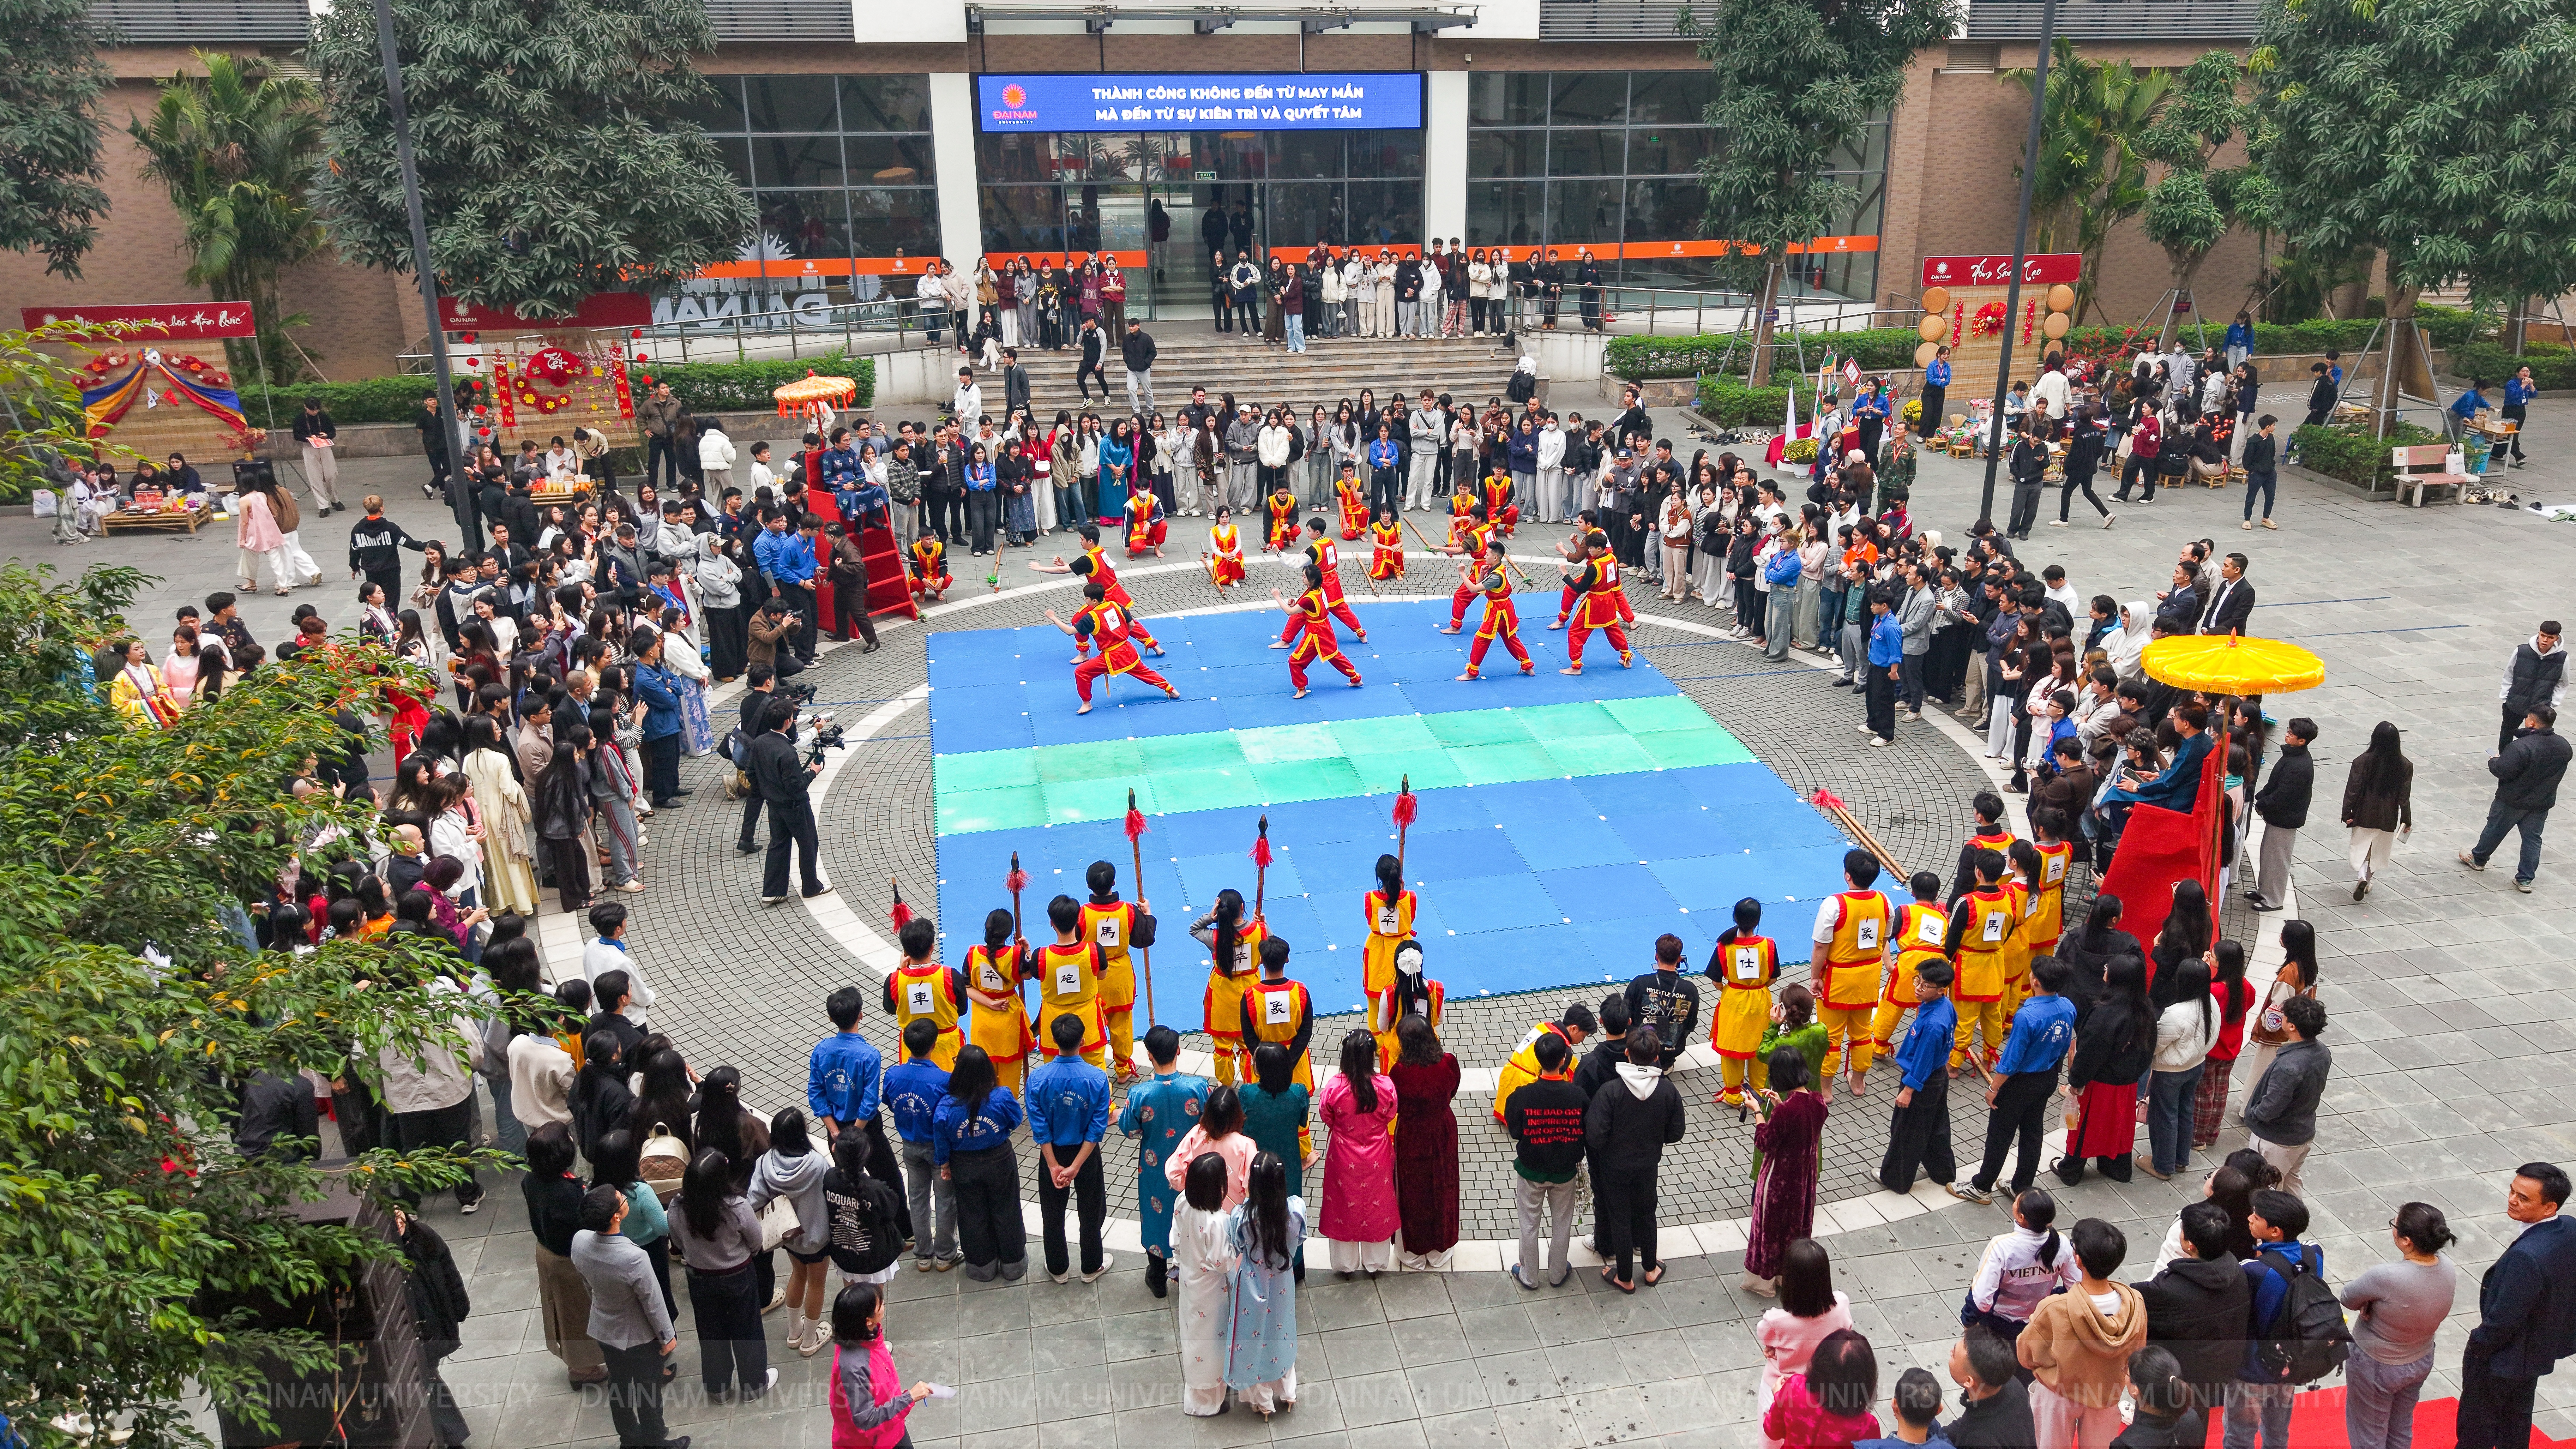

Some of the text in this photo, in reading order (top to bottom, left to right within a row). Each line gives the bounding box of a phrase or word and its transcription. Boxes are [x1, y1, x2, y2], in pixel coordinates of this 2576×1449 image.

[1092, 83, 1364, 99] THÀNH CÔNG KHÔNG ĐẾN TỪ MAY MẮN
[1095, 104, 1362, 122] MÀ ĐẾN TỪ SỰ KIÊN TRÌ VÀ QUYẾT TÂM
[1997, 262, 2012, 279] Sán
[2024, 260, 2041, 282] Tạo
[2051, 863, 2062, 874] 卒
[1381, 914, 1395, 926] 卒
[1987, 920, 1999, 932] 馬
[1101, 926, 1115, 938] 馬
[1861, 927, 1874, 940] 象
[1740, 958, 1755, 968] 仕
[984, 970, 999, 982] 卒
[913, 992, 929, 1006] 車
[1270, 1001, 1286, 1015] 象
